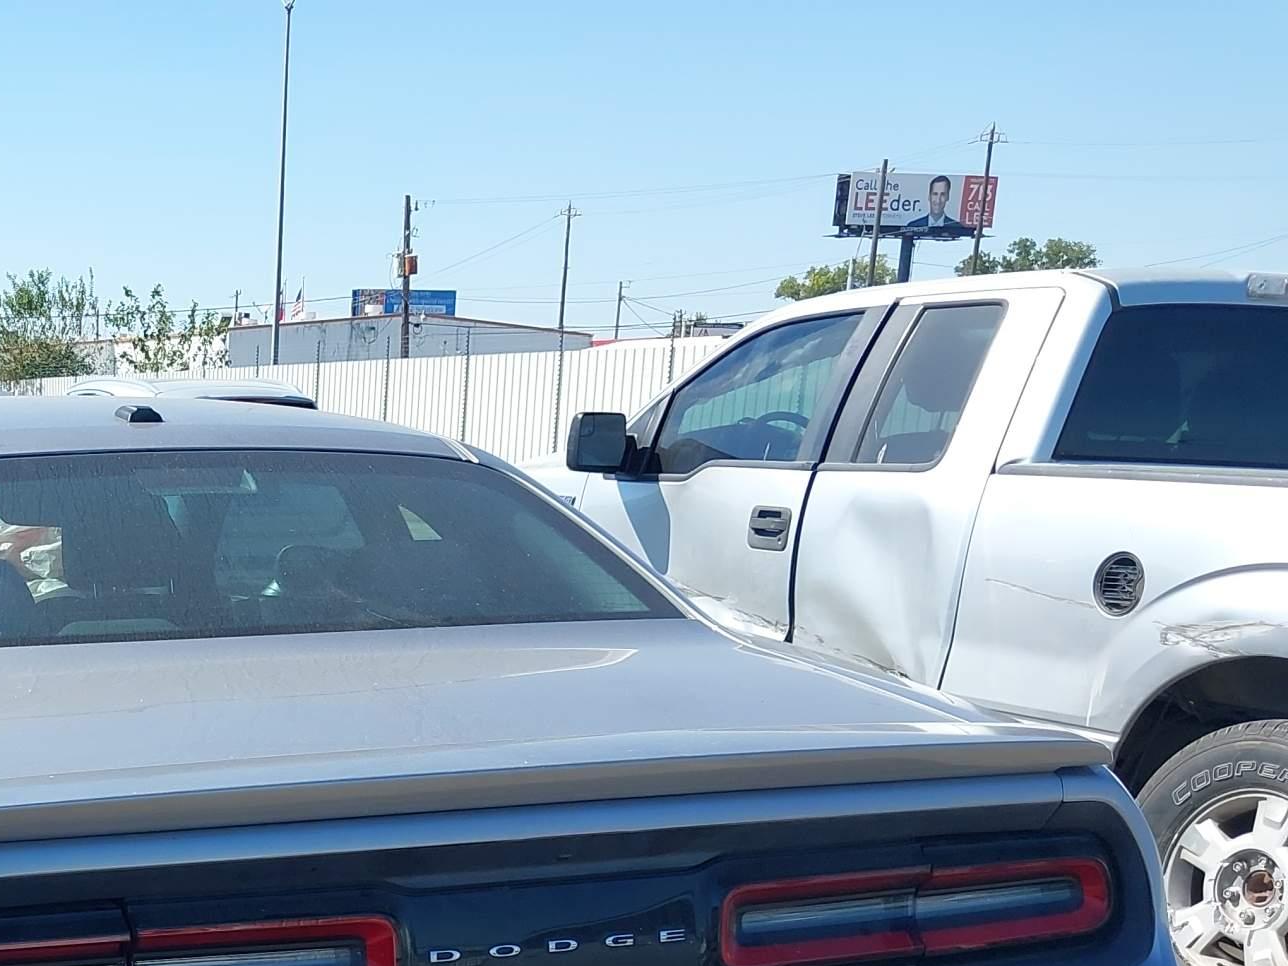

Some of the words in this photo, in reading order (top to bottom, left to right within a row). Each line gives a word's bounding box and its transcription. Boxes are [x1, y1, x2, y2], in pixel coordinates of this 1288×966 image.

[856, 179, 878, 191] Call
[884, 179, 900, 191] he
[854, 192, 922, 212] LEEder.
[967, 201, 990, 211] CAL
[429, 928, 686, 963] DODGE
